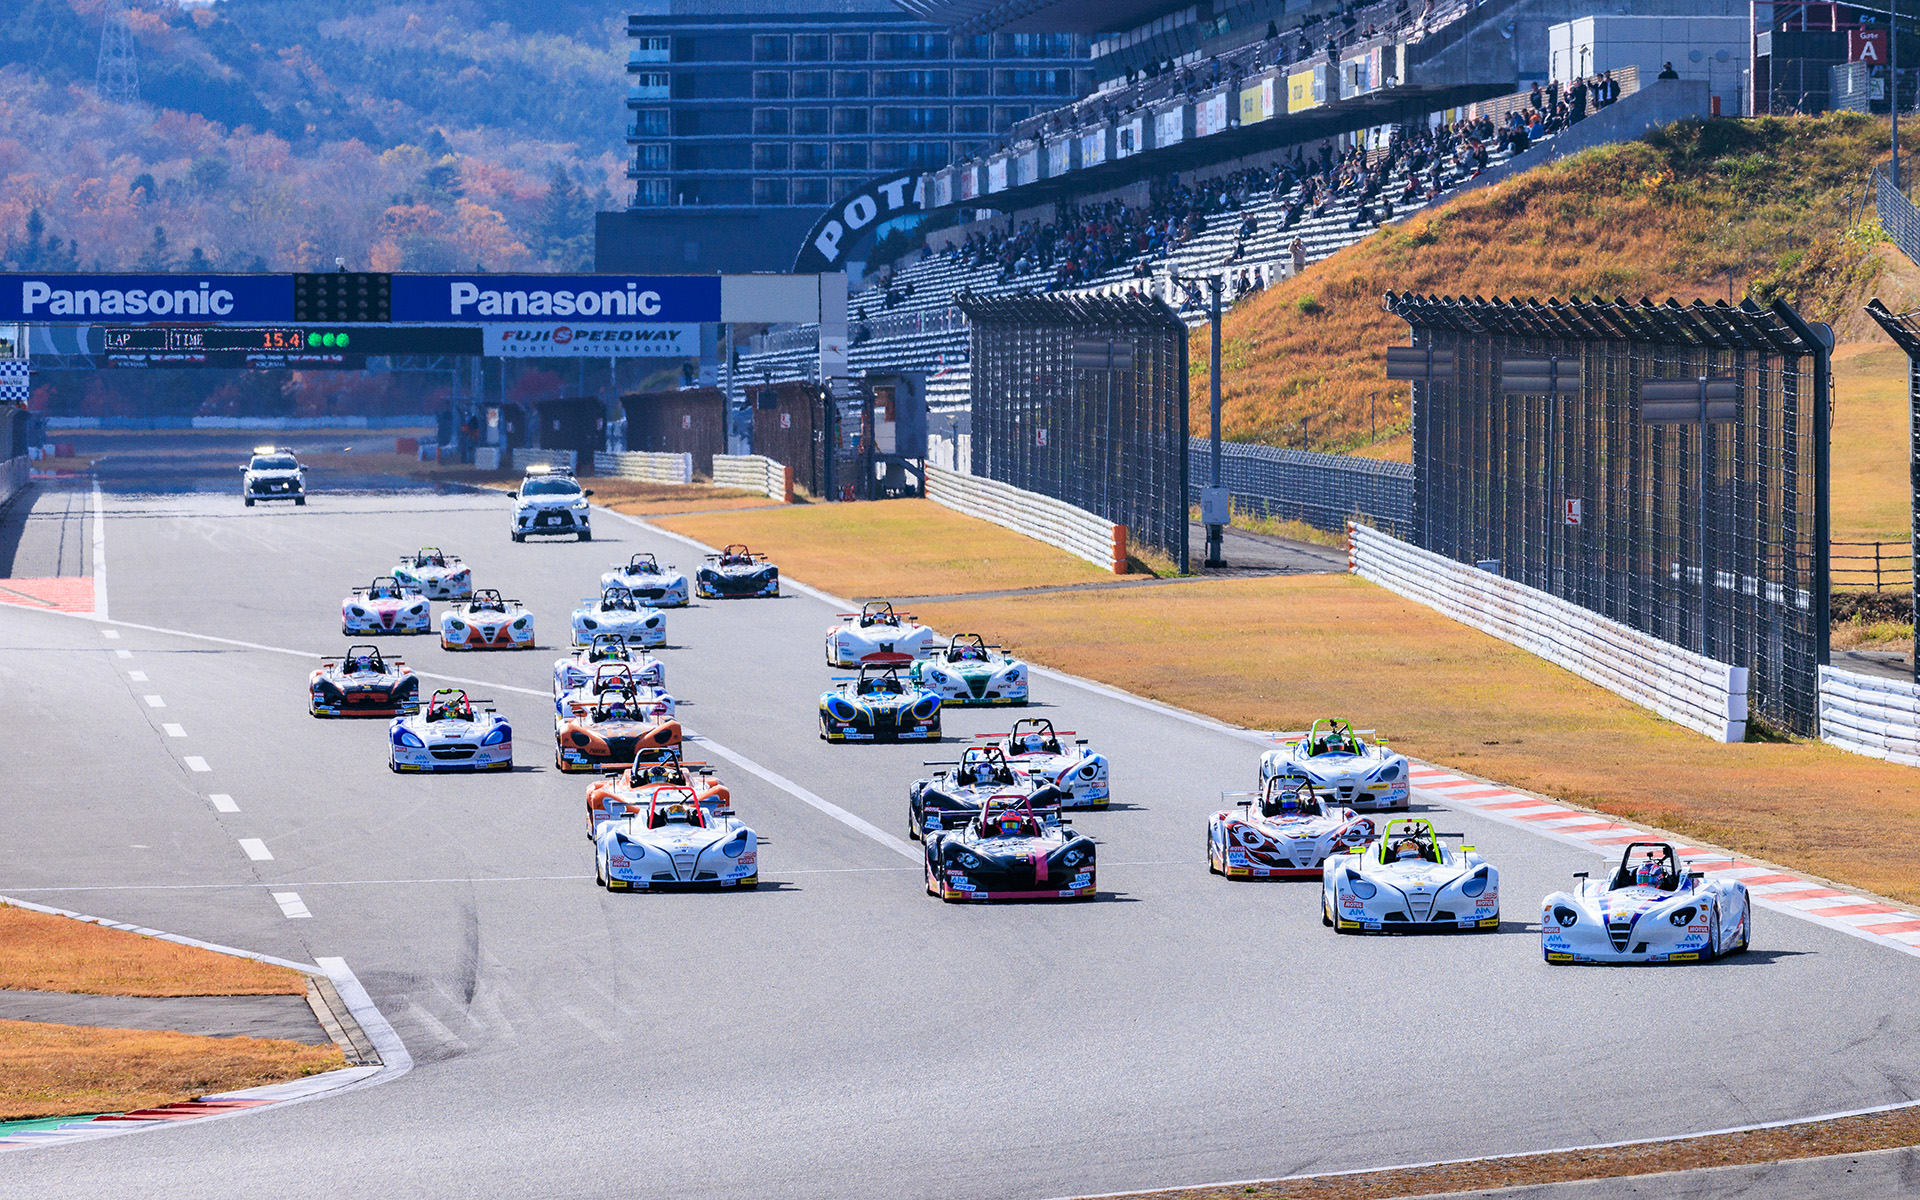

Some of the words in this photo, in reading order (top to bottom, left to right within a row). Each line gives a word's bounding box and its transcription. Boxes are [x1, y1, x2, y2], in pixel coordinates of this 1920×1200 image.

[1860, 41, 1878, 60] A
[22, 281, 234, 316] Panasonic
[450, 282, 661, 317] Panasonic
[107, 333, 131, 346] LAP
[175, 333, 204, 346] TIME
[263, 332, 301, 348] 15.4
[502, 330, 550, 341] FUJI
[552, 326, 682, 345] SPEEDWAY
[1561, 916, 1576, 925] M
[1673, 914, 1687, 925] M
